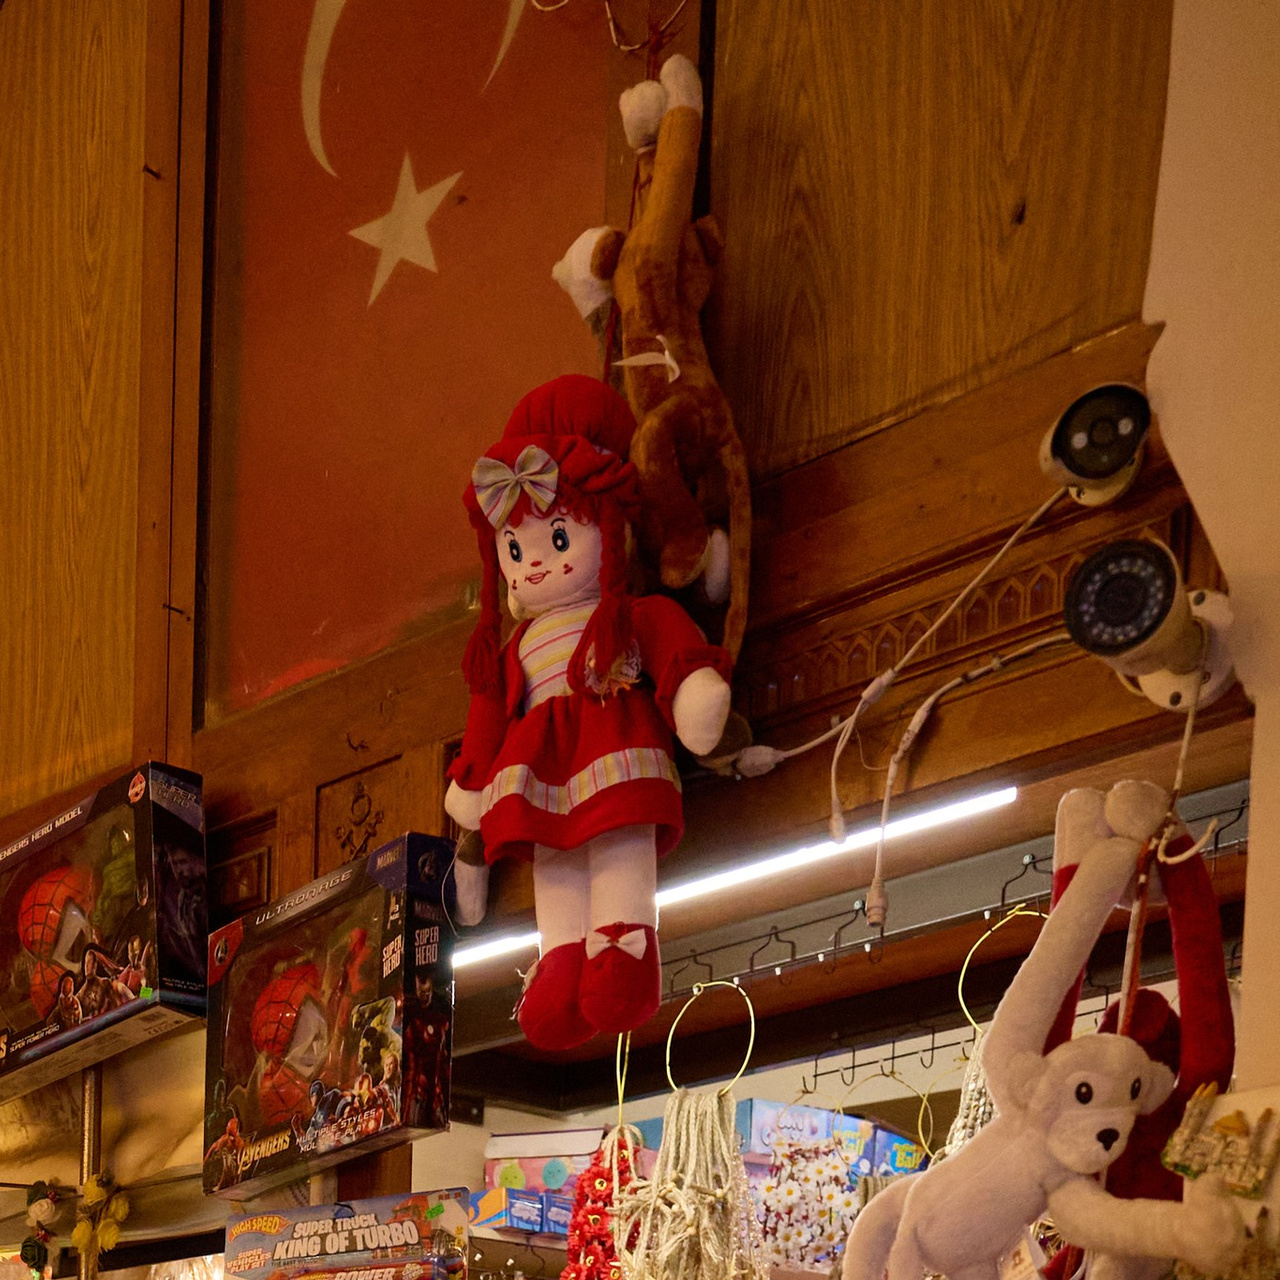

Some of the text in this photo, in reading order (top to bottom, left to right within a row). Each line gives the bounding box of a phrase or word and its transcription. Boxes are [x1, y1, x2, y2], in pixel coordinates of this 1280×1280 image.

[30, 822, 54, 842] HERO
[55, 806, 84, 829] MODEL
[254, 868, 354, 927] ULTRON AGE
[382, 934, 402, 963] SUPER
[414, 925, 440, 948] SUPER
[382, 951, 402, 980] HERO
[415, 943, 439, 968] HERO
[231, 1215, 280, 1242] HIGH SPEED
[272, 1221, 420, 1260] KING OF TURBO
[292, 1213, 378, 1240] SUPER TRUCK
